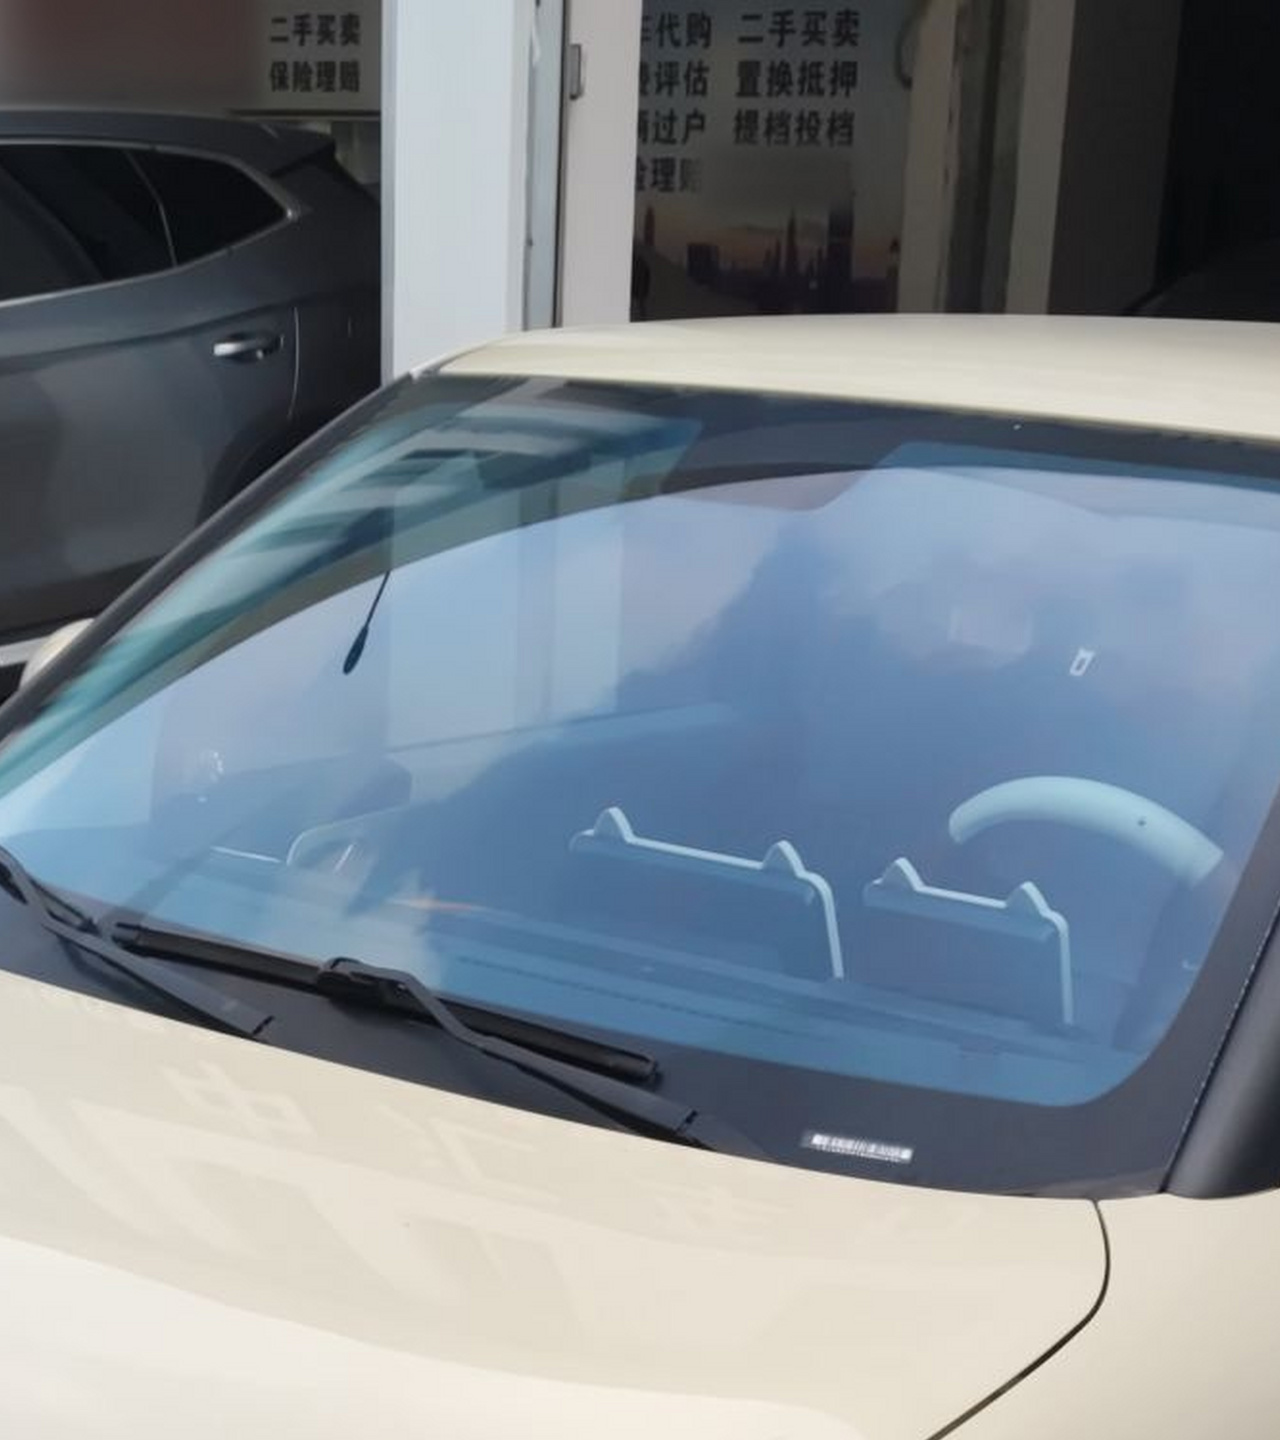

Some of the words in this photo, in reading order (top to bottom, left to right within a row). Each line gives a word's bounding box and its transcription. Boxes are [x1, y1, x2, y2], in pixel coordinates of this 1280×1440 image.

[270, 12, 360, 47] 二手买卖
[738, 9, 860, 48] 二手买卖
[270, 60, 360, 93] 保险理赔
[736, 60, 858, 98] 置换抵押
